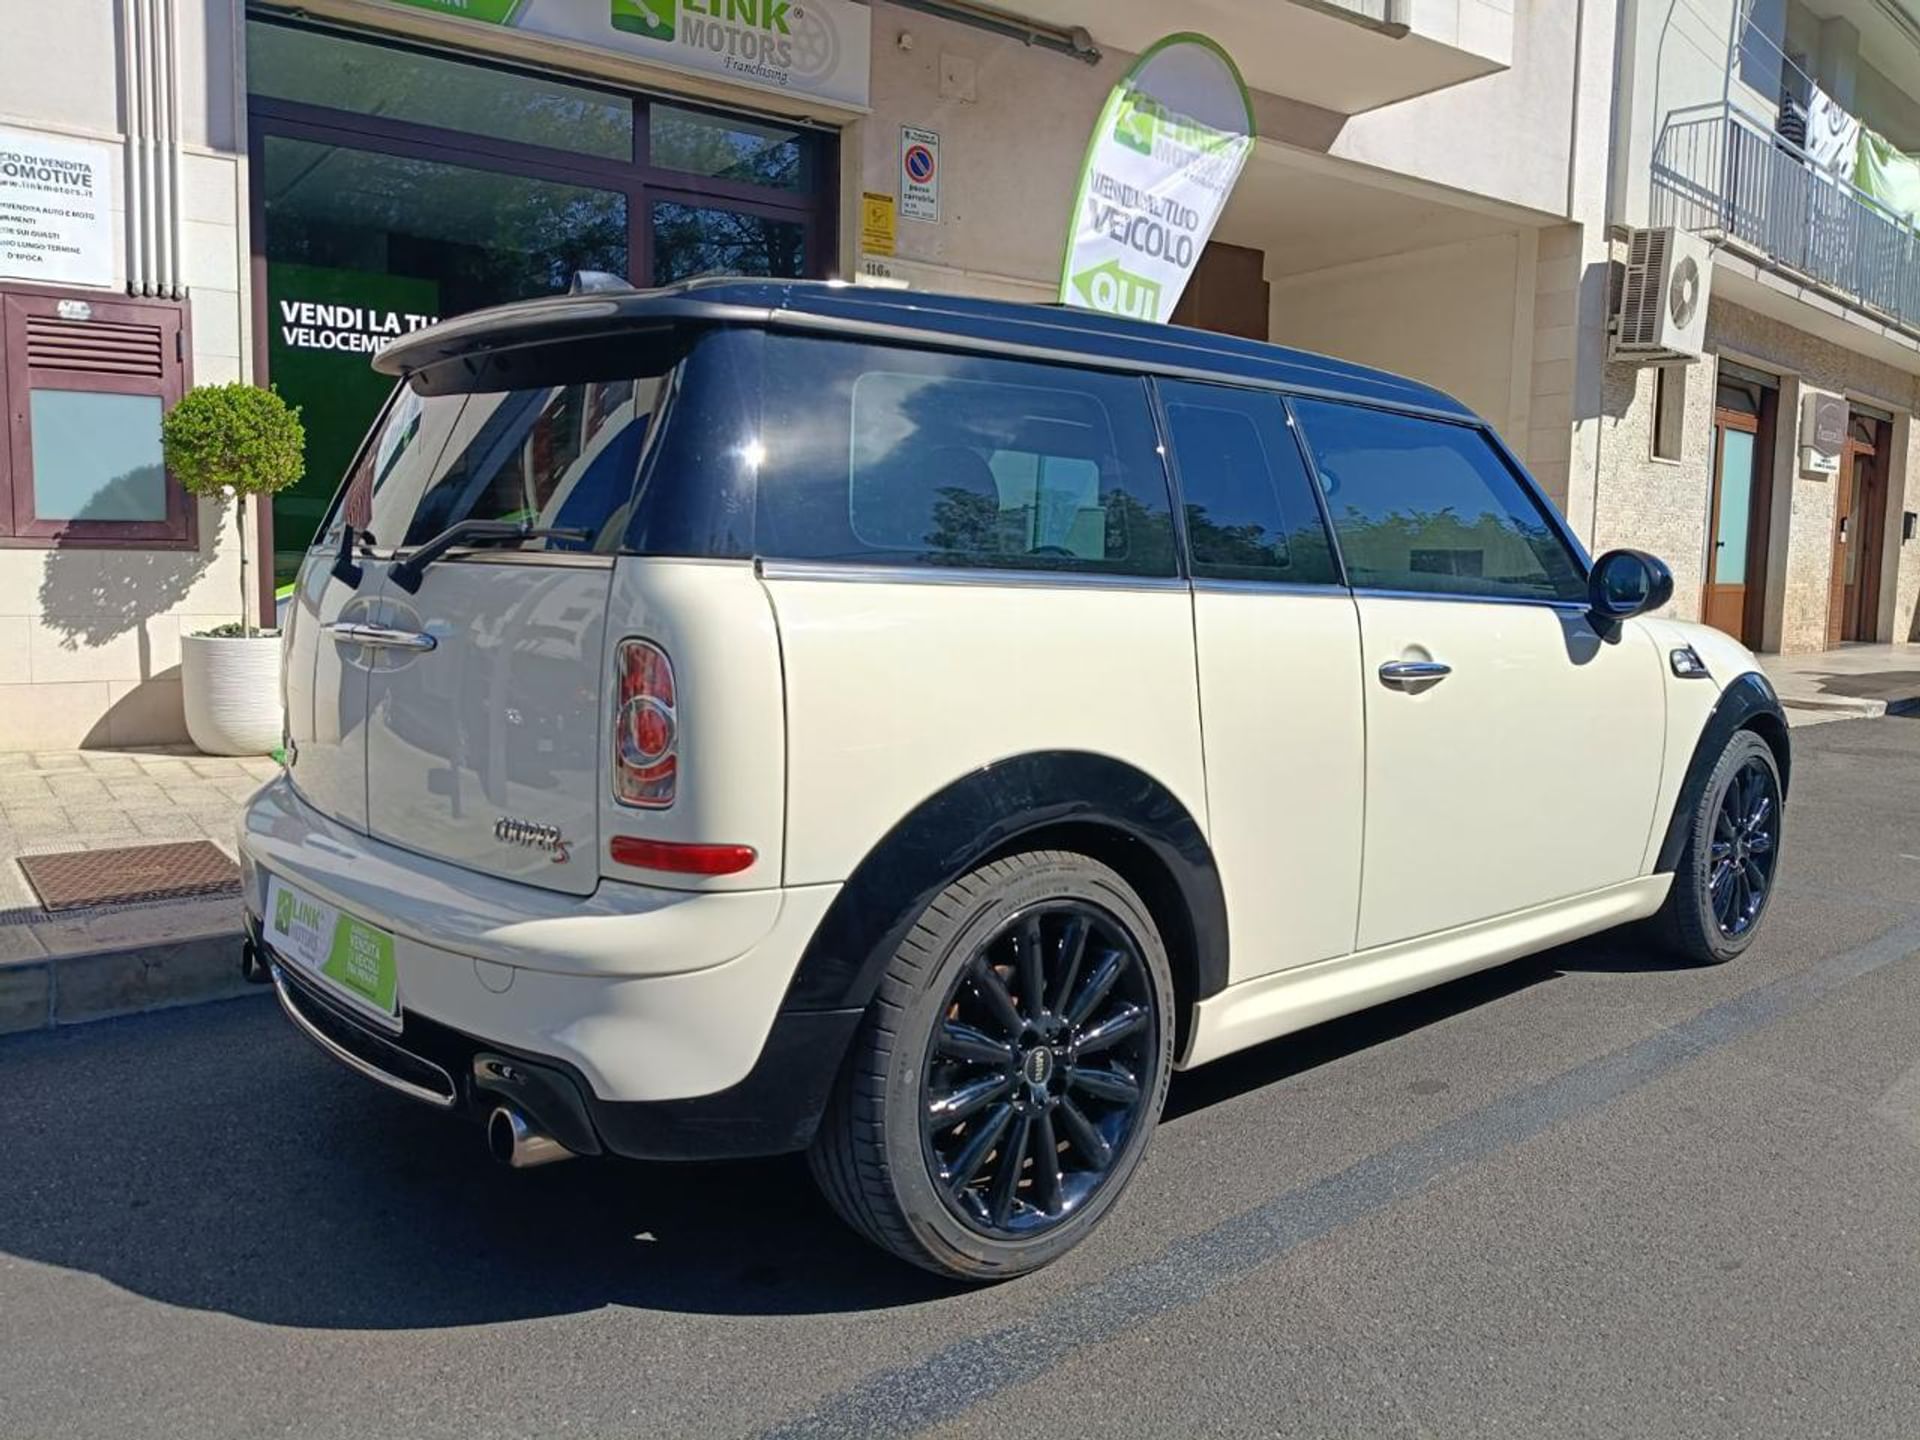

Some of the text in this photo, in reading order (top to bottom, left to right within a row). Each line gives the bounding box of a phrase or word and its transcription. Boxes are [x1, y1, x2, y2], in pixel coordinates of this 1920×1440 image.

[682, 16, 792, 68] MOTORS
[724, 56, 788, 85] Franchising
[1, 162, 92, 188] OMOTIVE
[24, 155, 38, 165] DI
[40, 158, 91, 173] VENDITA
[1088, 198, 1193, 269] VEICOLO
[1090, 271, 1156, 322] QUI
[280, 300, 363, 330] VENDI
[368, 310, 401, 334] LA
[282, 326, 396, 353] VELOCEME
[493, 816, 573, 864] COOPER S
